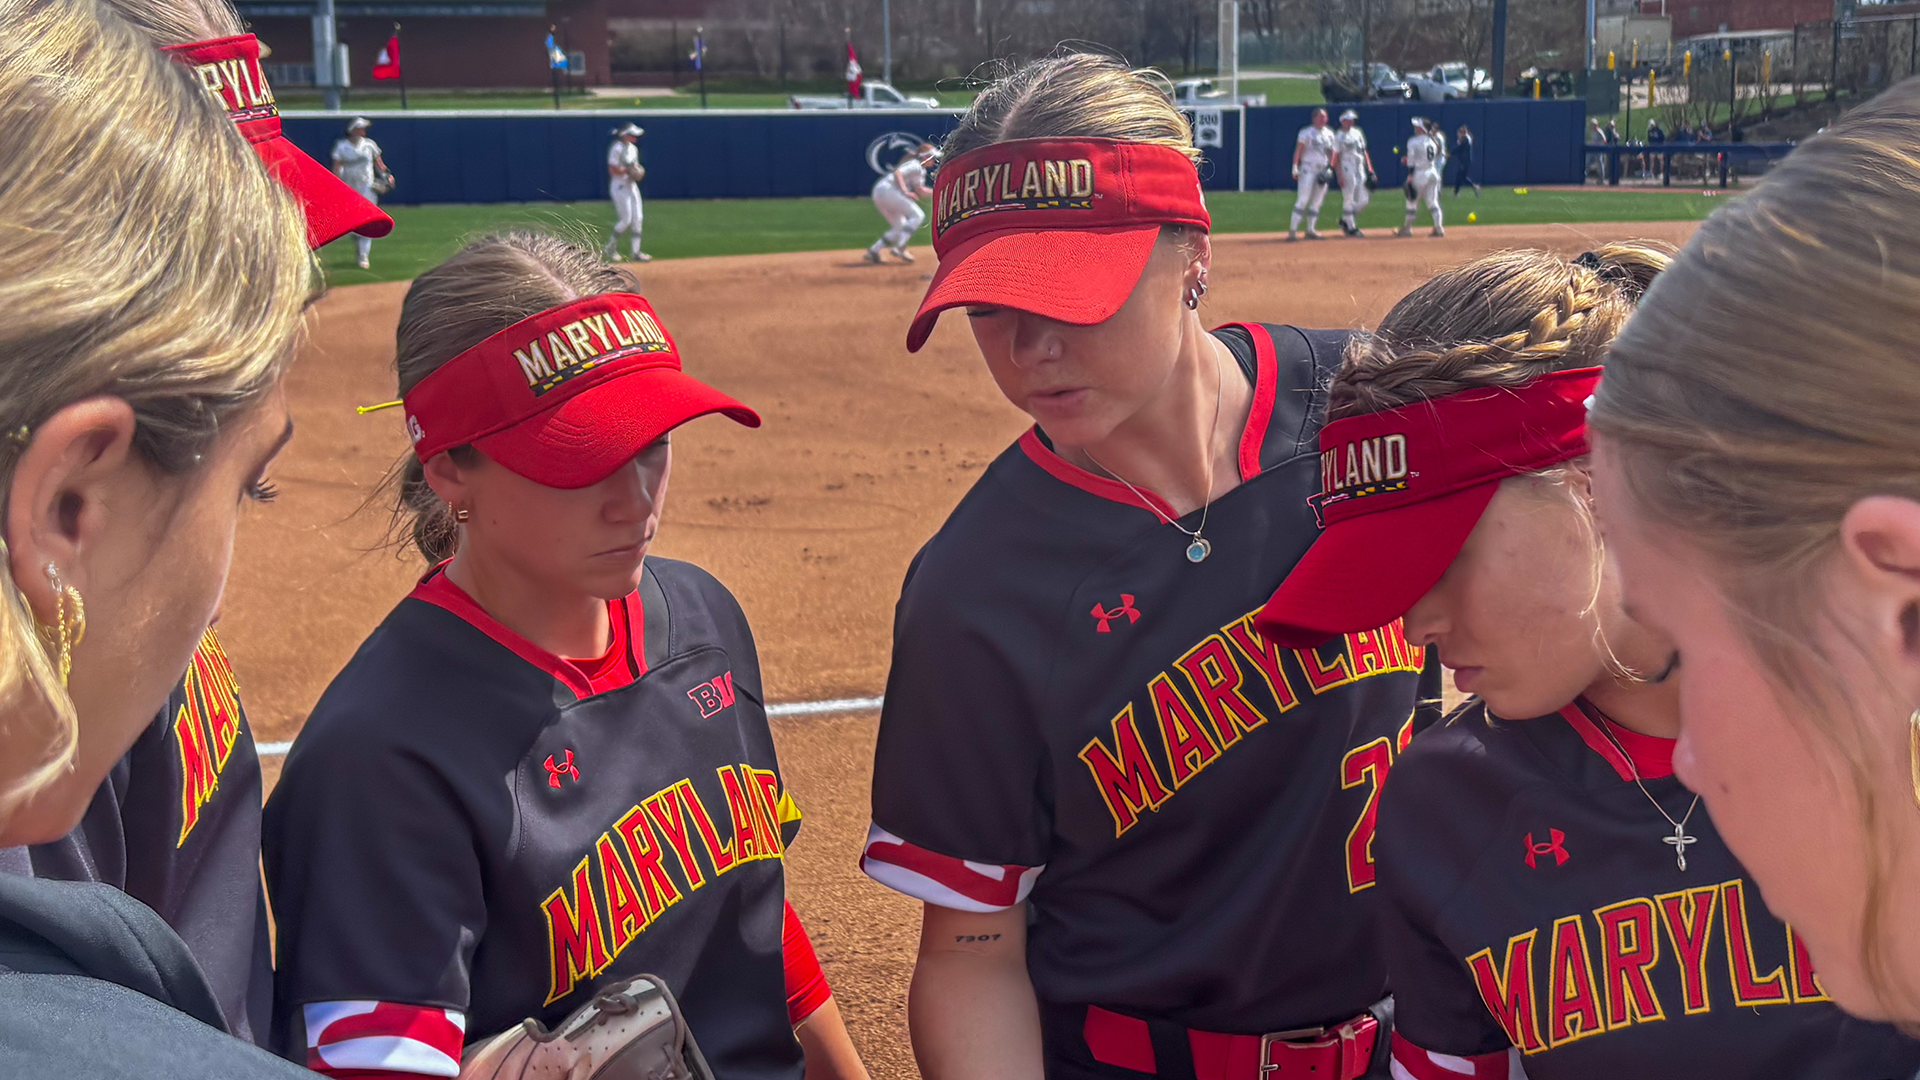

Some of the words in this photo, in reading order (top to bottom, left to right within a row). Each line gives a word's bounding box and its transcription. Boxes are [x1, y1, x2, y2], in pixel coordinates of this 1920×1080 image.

[1198, 114, 1219, 126] 200
[937, 158, 1094, 227] MARYLAND
[512, 308, 667, 387] MARYLAND
[1341, 706, 1416, 894] 2
[541, 763, 784, 1008] MARYLAND
